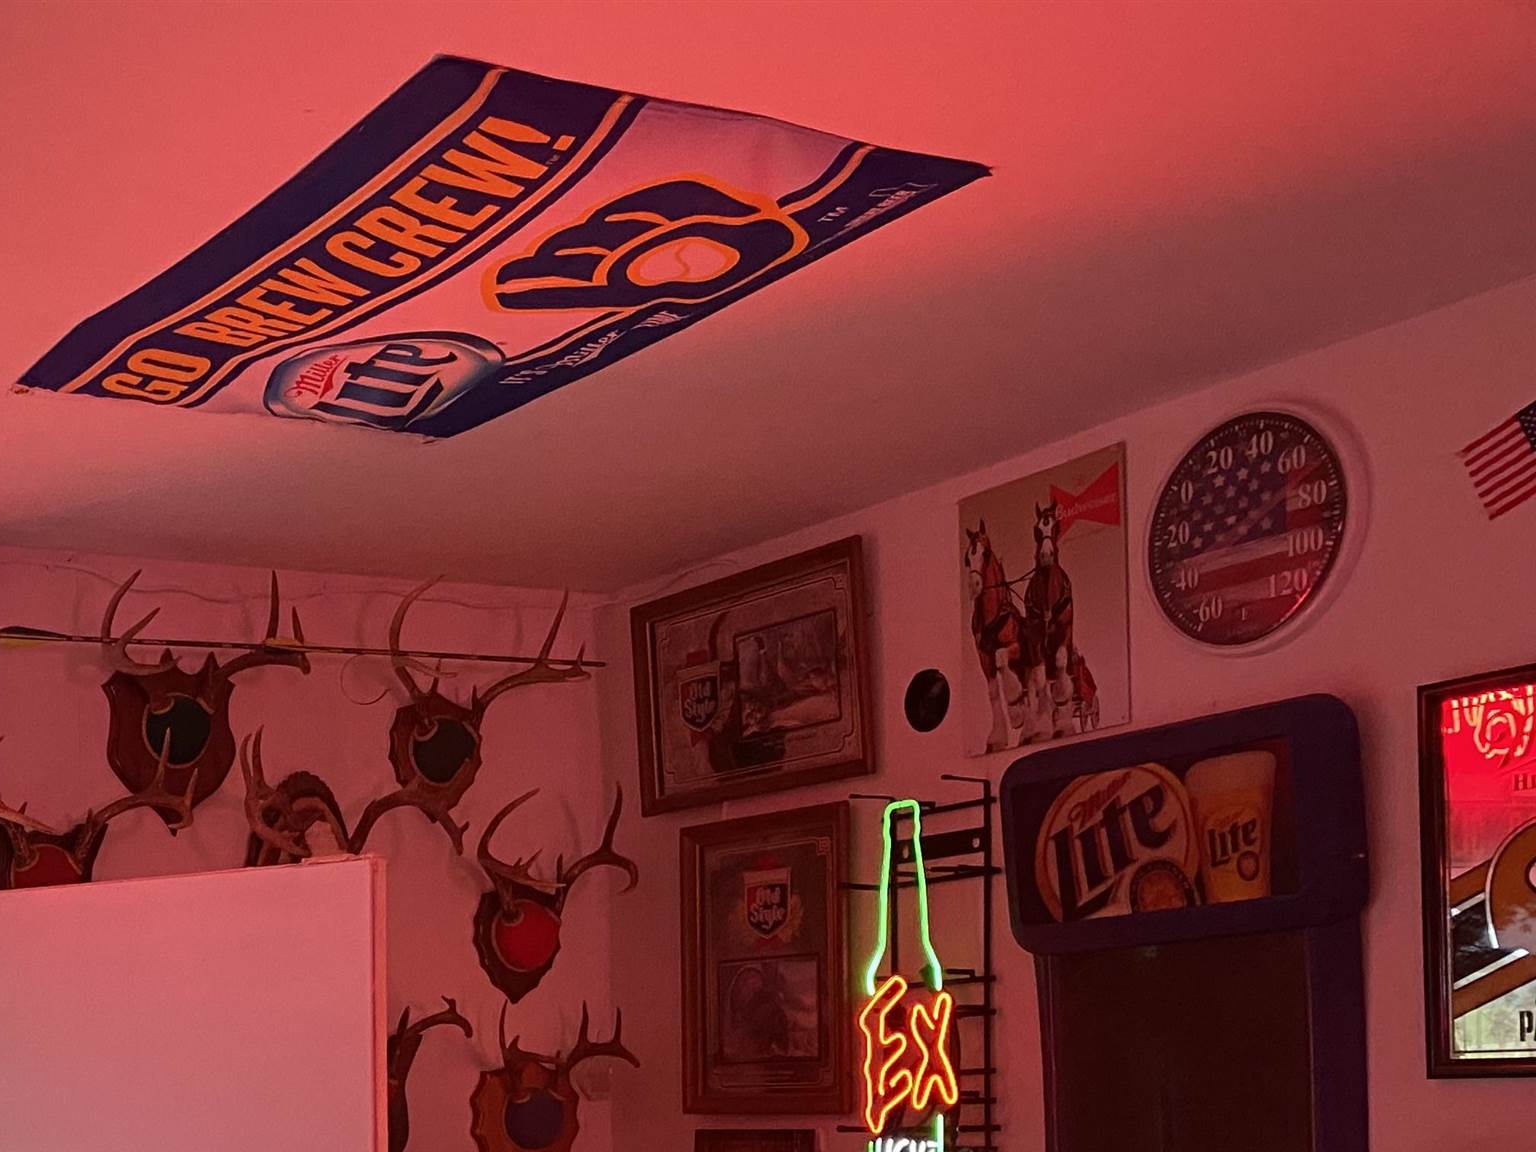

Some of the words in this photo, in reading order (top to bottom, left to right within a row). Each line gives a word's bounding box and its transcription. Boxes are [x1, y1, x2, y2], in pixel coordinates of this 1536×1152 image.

[101, 348, 212, 402] GO
[173, 257, 371, 348] BREW
[324, 116, 576, 278] CREW!
[284, 352, 348, 400] Miller
[1245, 430, 1274, 458] 40
[1277, 444, 1306, 474] 60
[1206, 446, 1234, 474] 20
[1180, 480, 1194, 503] 0
[1297, 479, 1328, 507] 80
[1286, 526, 1324, 558] 100
[1268, 567, 1309, 598] 120
[1049, 783, 1178, 924] Lite
[1206, 818, 1257, 867] Lite
